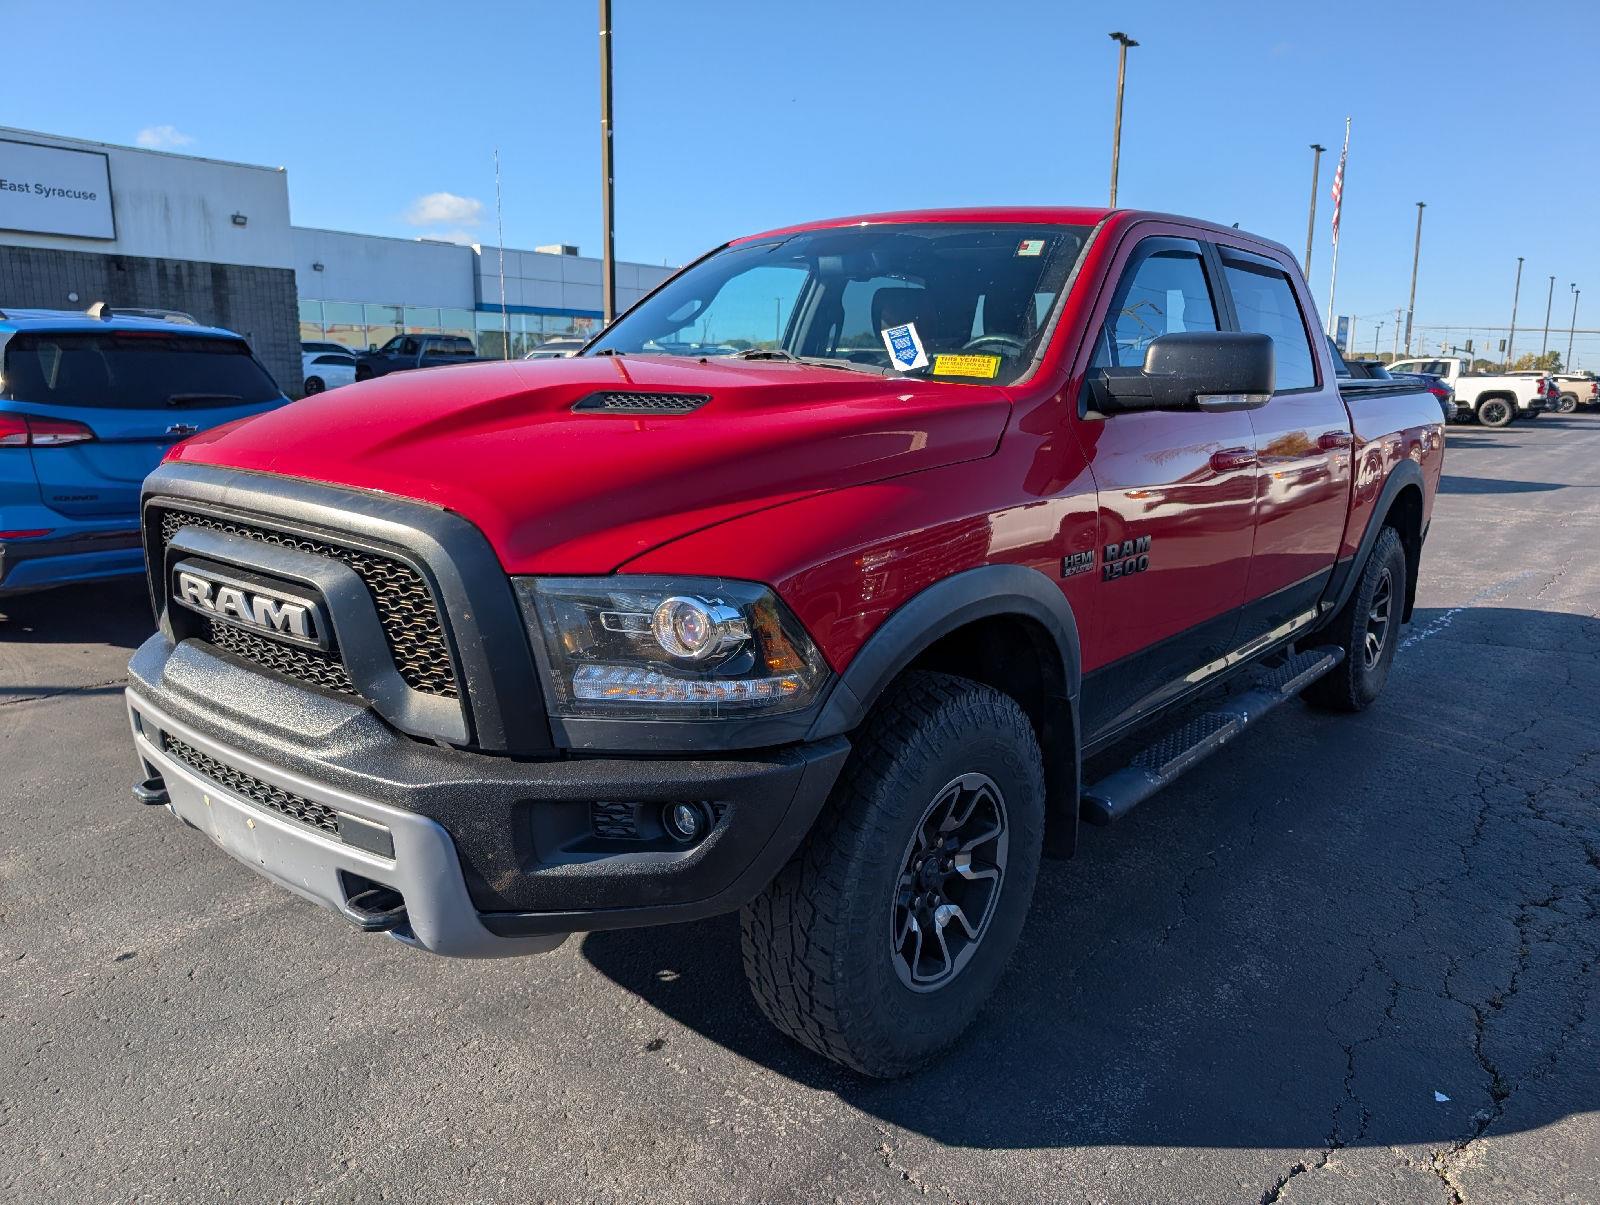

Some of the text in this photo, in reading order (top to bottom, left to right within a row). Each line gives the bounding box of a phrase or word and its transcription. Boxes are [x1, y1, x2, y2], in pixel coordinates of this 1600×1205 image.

[0, 179, 97, 201] East Syracuse
[1064, 549, 1095, 568] HEMI
[1103, 534, 1152, 562] RAM
[1103, 555, 1150, 581] 1500
[179, 571, 309, 638] RAM
